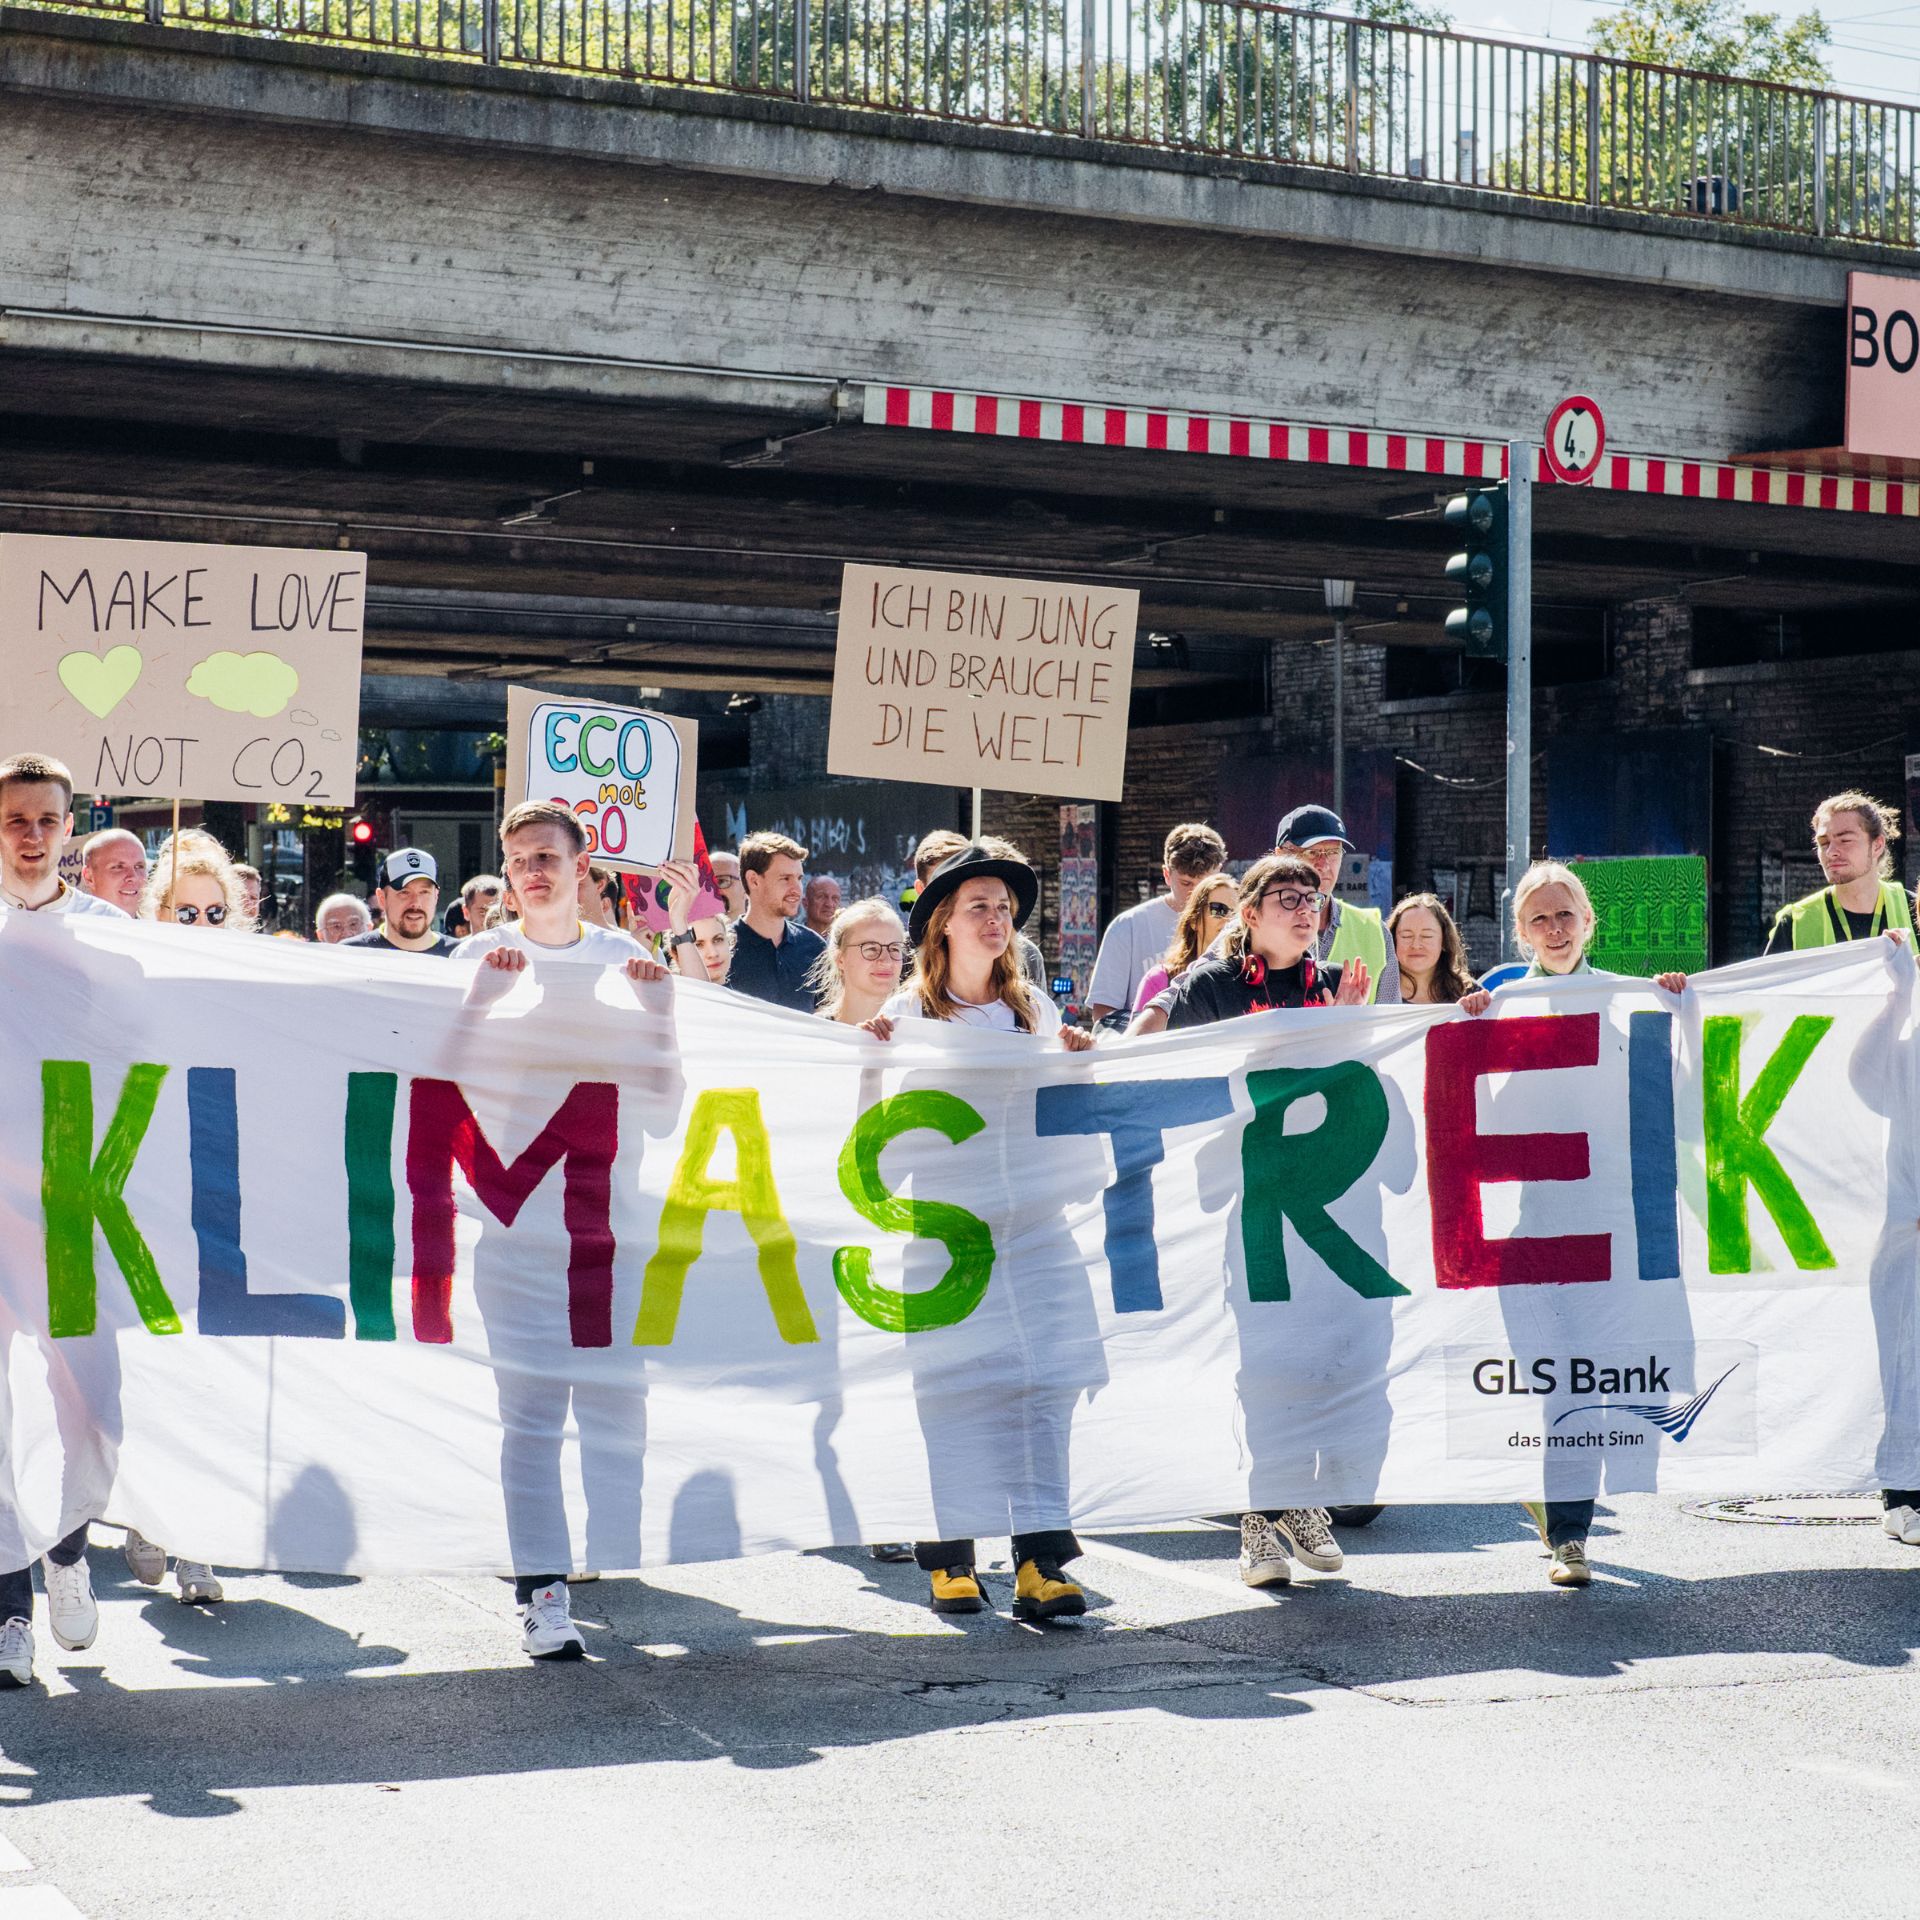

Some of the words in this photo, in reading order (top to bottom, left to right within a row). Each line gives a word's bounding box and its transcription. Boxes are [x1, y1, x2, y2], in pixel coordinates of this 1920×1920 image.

[1851, 306, 1920, 374] BO
[1563, 419, 1577, 459] 4
[38, 568, 212, 632] MAKE
[250, 570, 361, 633] LOVE
[871, 581, 932, 632] ICH
[947, 589, 1006, 641] BIN
[1016, 594, 1119, 651] JUNG
[865, 645, 938, 687] UND
[949, 652, 1112, 704] BRAUCHE
[95, 734, 199, 788] NOT
[545, 711, 652, 781] ECO
[872, 703, 948, 753] DIE
[973, 711, 1102, 767] WELT
[93, 810, 107, 832] P
[598, 779, 648, 811] not
[550, 797, 628, 855] GO
[40, 1010, 1838, 1348] KLIMASTREIK
[1473, 1357, 1558, 1395] GLS
[1570, 1355, 1671, 1394] Bank
[1508, 1431, 1542, 1448] das
[1547, 1431, 1605, 1448] macht
[1608, 1430, 1644, 1447] Sinn
